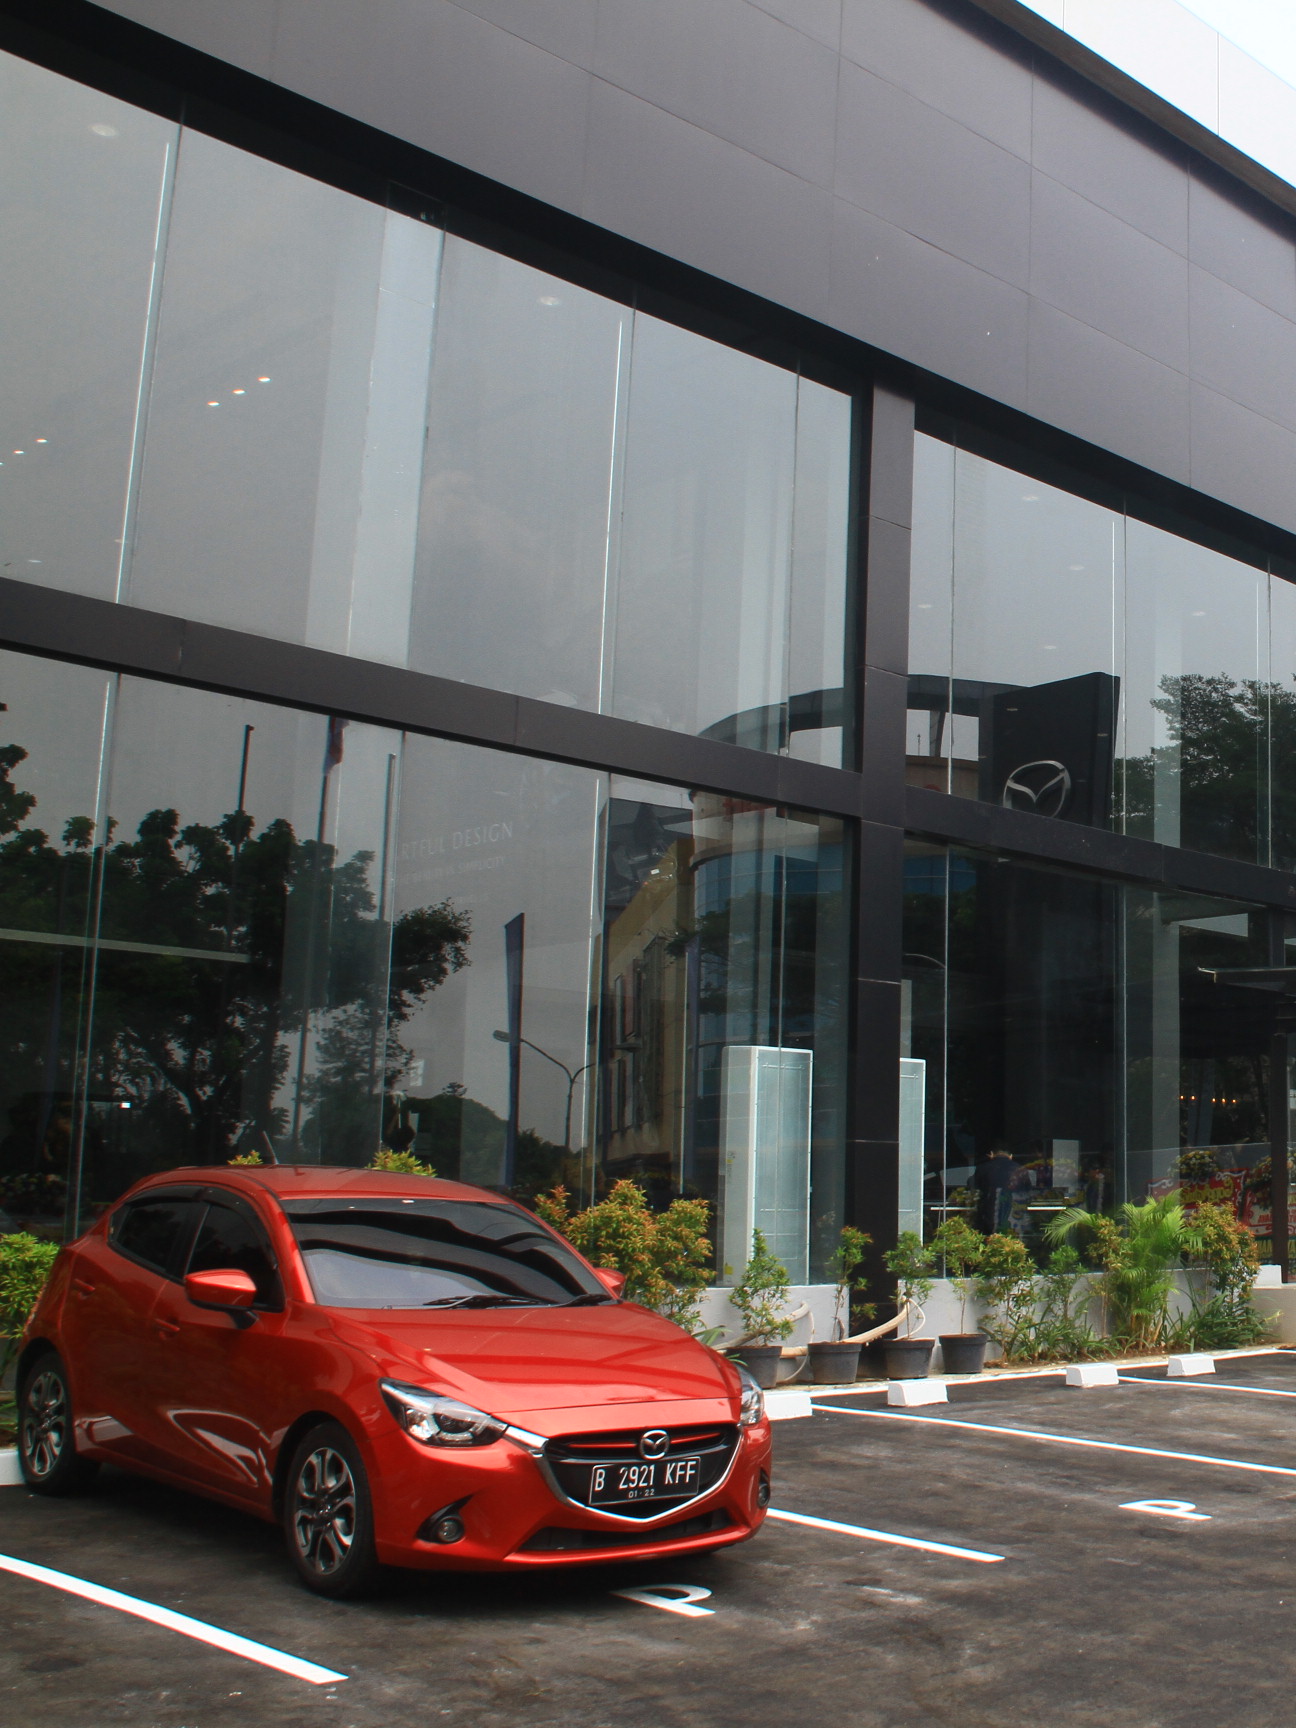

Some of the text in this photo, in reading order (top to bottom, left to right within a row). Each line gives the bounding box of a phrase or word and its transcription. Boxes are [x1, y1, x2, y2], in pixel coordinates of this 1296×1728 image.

[453, 821, 513, 849] DESIGN
[594, 1461, 697, 1491] B 2921 KFF
[1118, 1499, 1212, 1520] P
[610, 1583, 716, 1618] P
